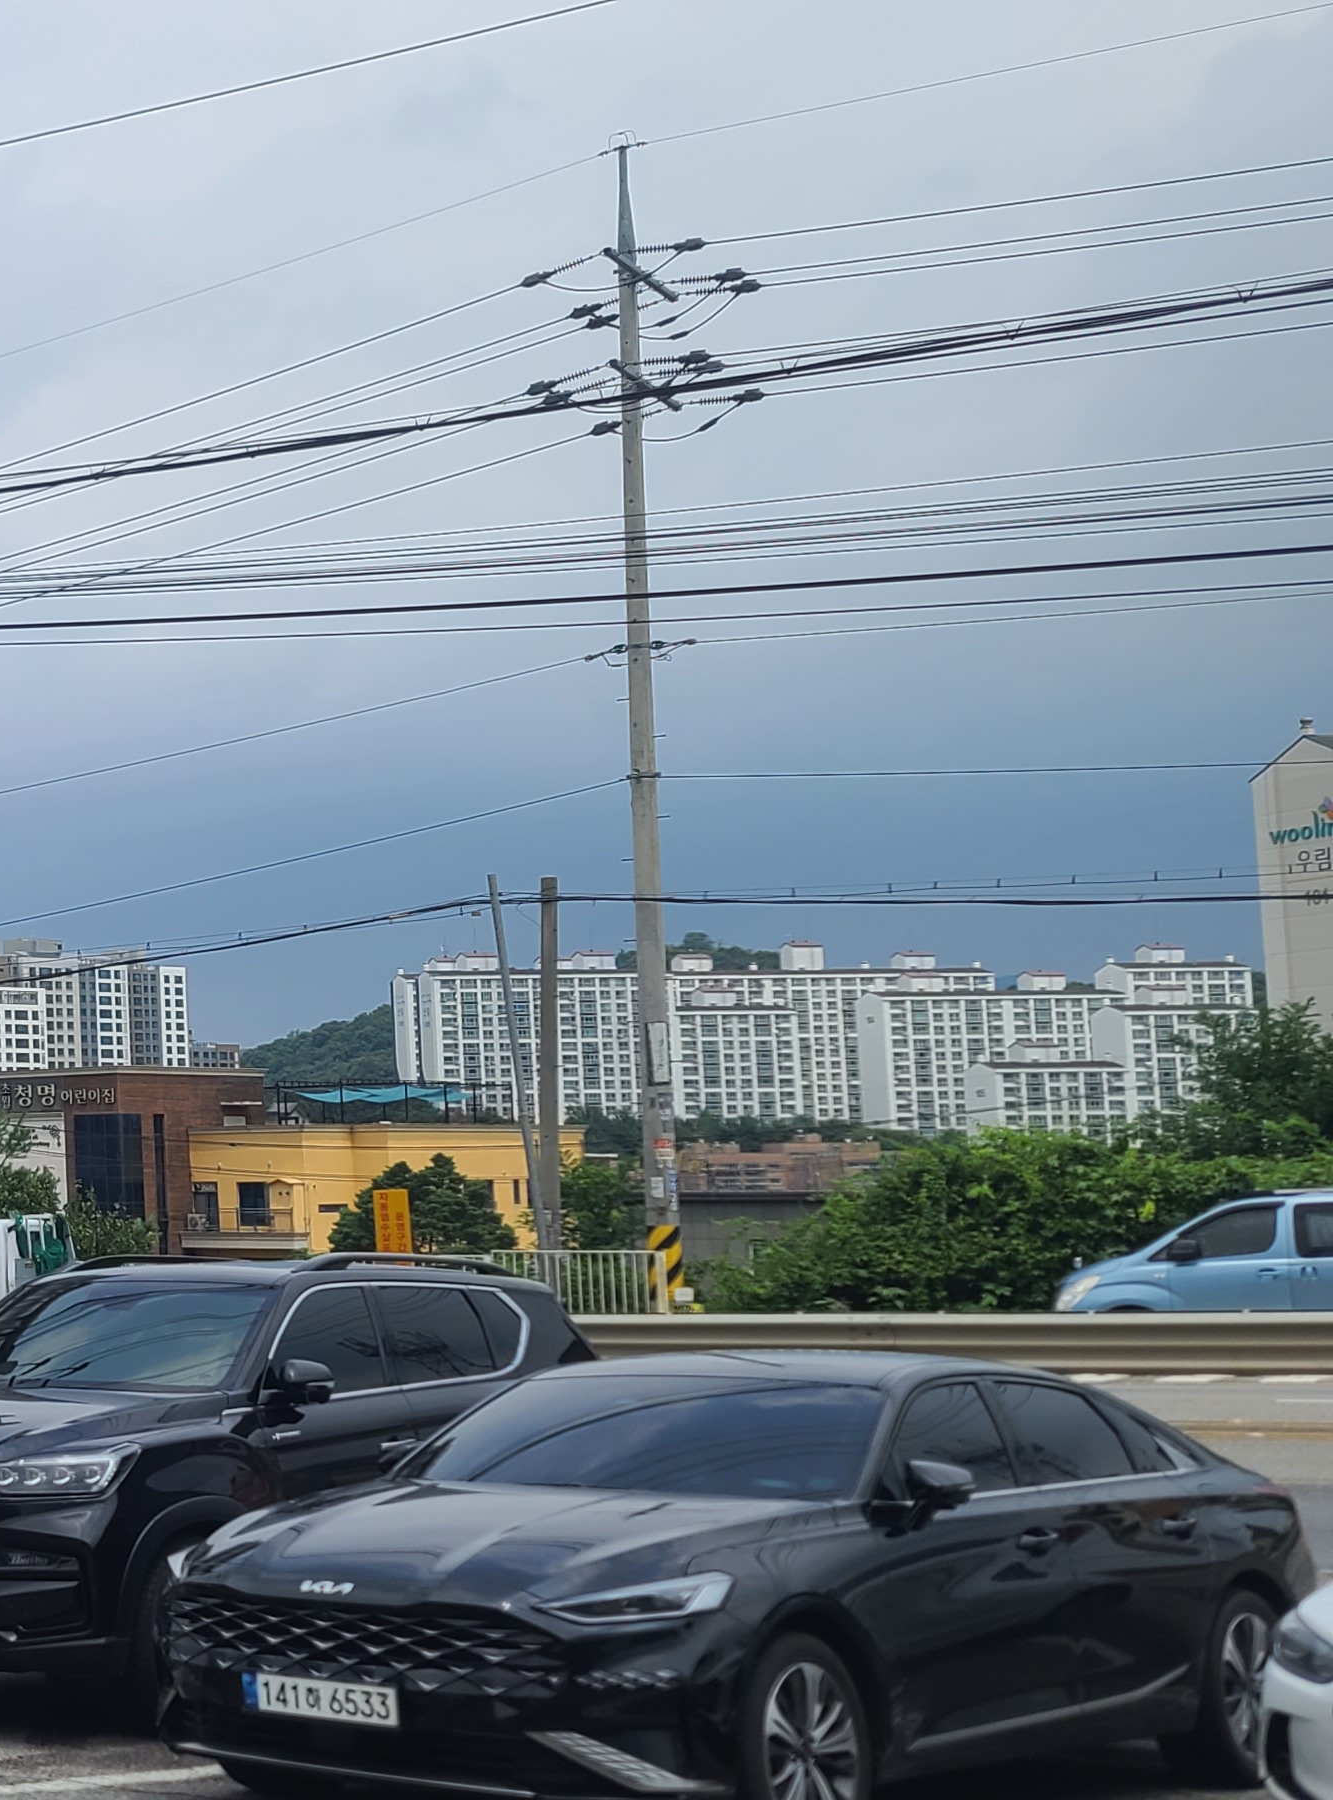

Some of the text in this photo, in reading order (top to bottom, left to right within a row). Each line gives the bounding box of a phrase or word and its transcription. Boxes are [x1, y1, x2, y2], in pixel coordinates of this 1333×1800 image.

[14, 1084, 56, 1107] 청명
[60, 1088, 116, 1105] 어린이집
[329, 1687, 390, 1720] 6533
